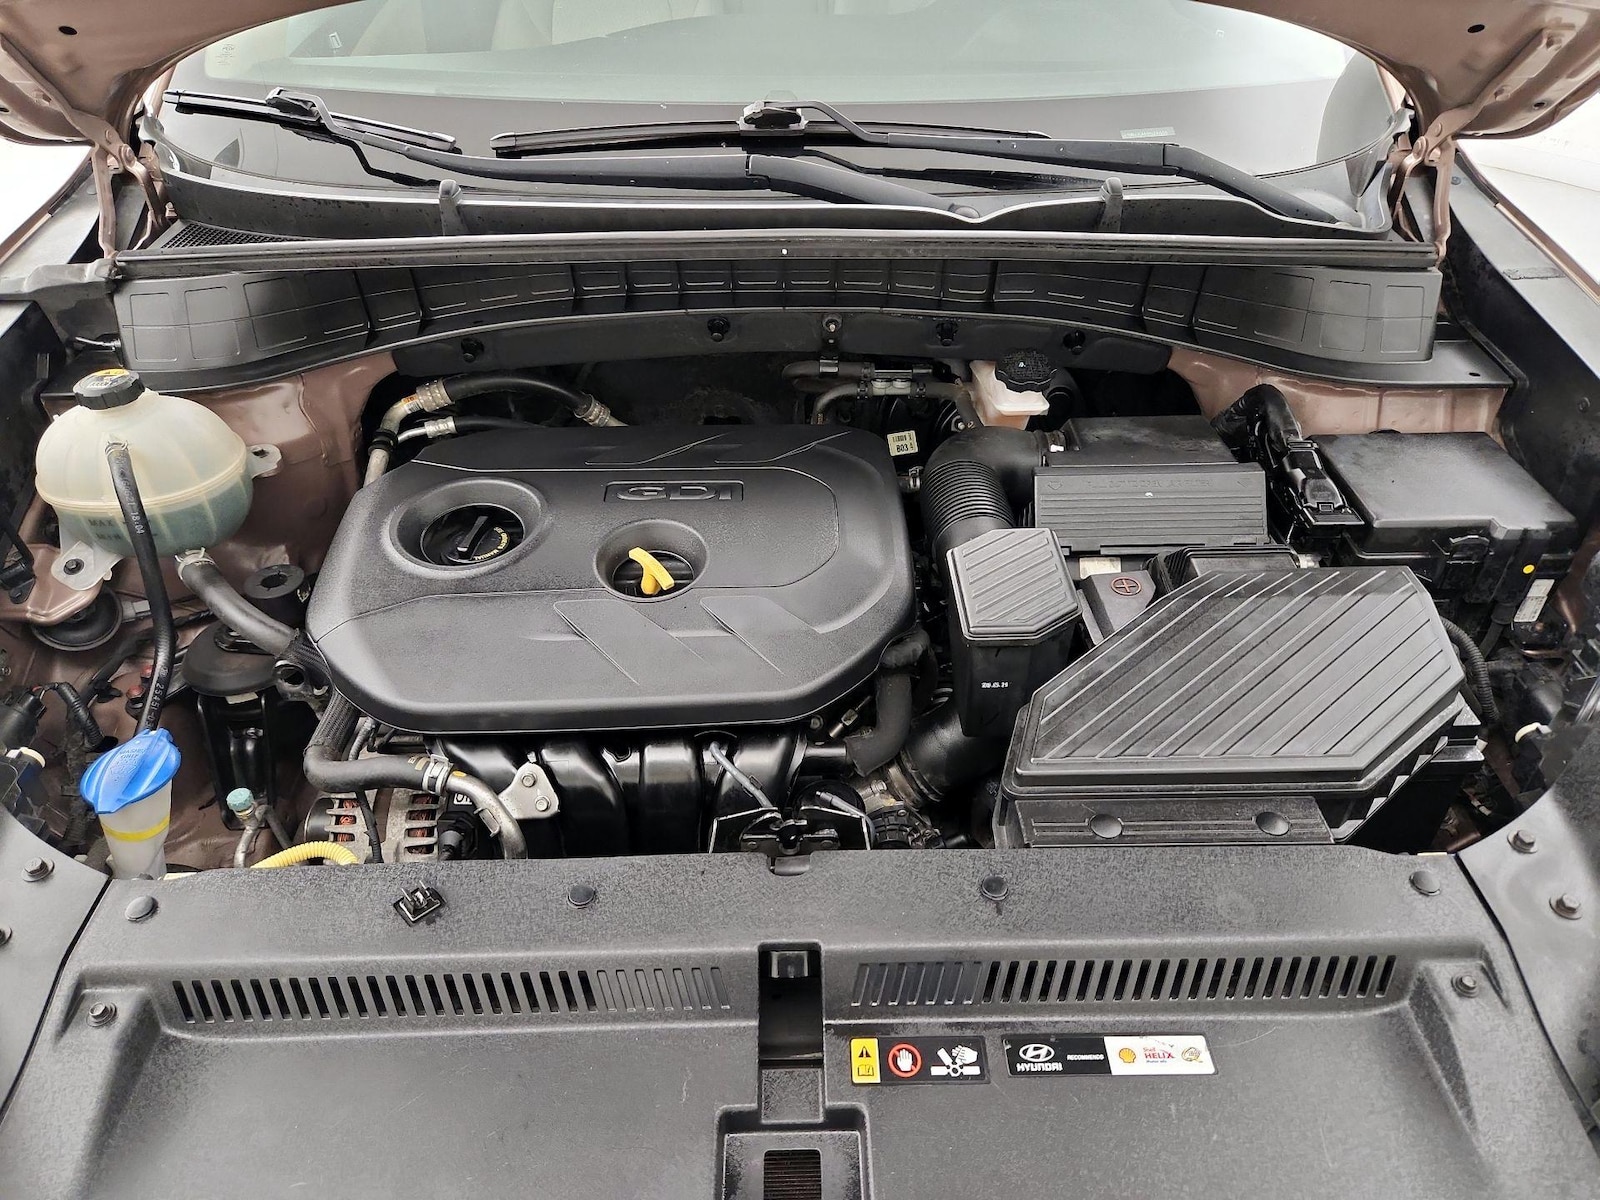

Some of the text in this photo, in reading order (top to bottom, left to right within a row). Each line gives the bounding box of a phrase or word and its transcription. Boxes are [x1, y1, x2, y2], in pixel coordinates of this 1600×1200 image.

[617, 485, 731, 500] GDI
[1067, 1053, 1104, 1061] RECOMMENDS
[1144, 1052, 1174, 1060] HELIX
[1016, 1062, 1063, 1072] HYUNDAI
